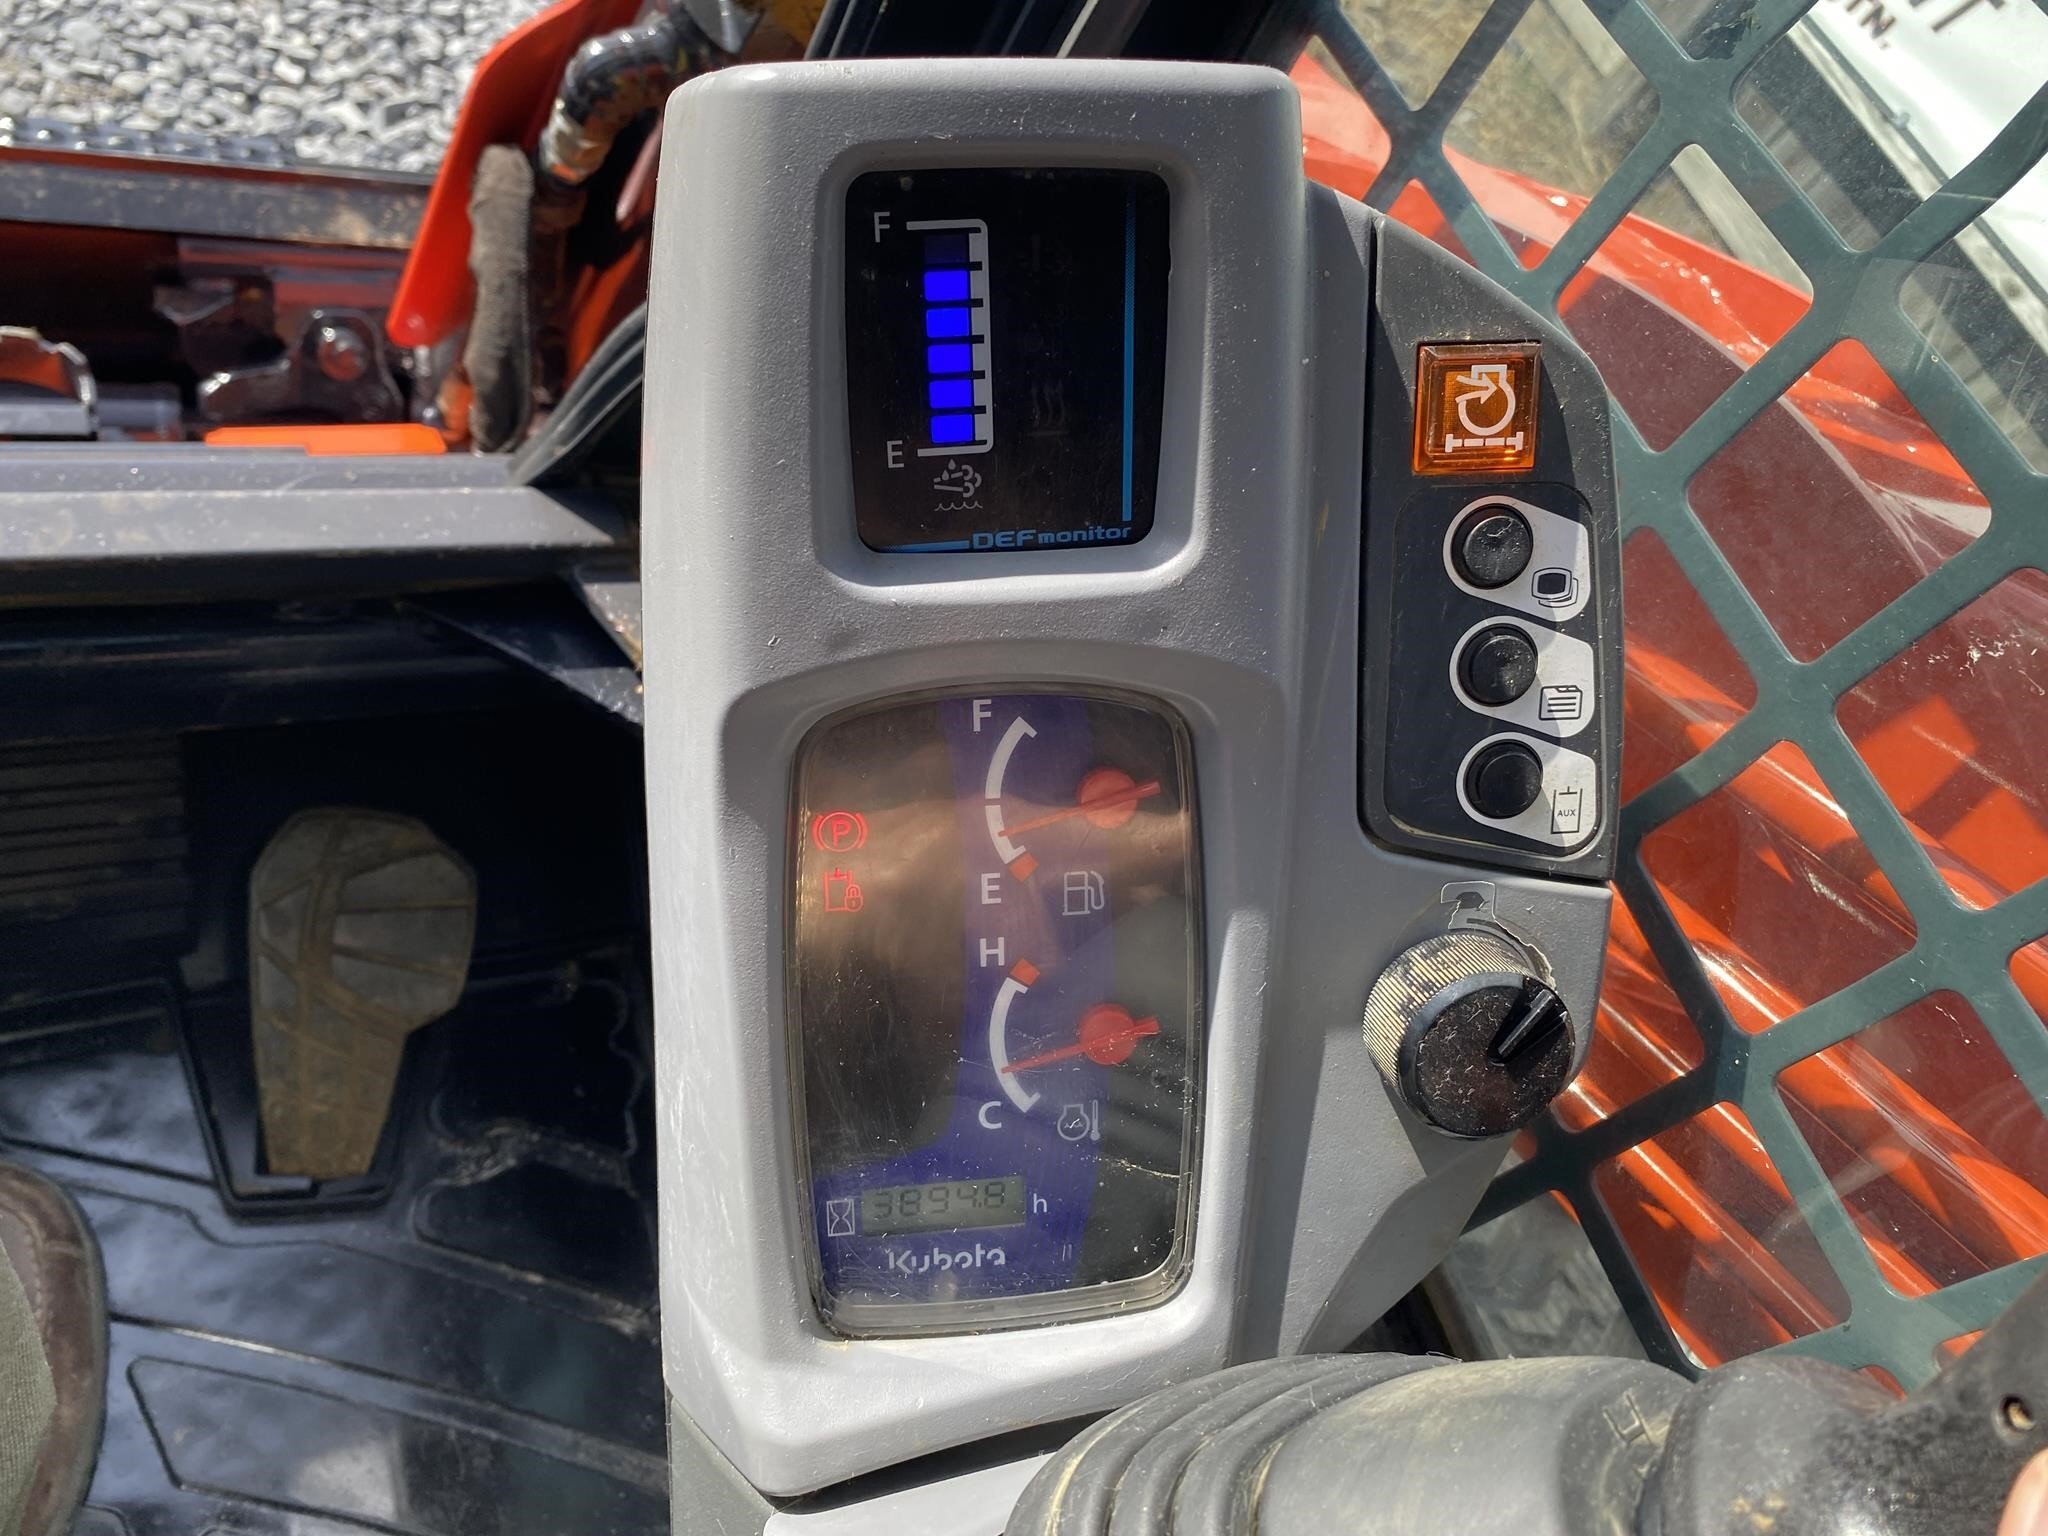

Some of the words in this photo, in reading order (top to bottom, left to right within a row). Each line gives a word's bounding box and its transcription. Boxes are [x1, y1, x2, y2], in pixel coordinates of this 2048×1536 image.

[873, 211, 891, 243] F
[886, 440, 905, 469] E
[971, 699, 993, 733] F
[1557, 808, 1576, 817] AUX
[831, 818, 852, 848] P
[980, 873, 1003, 905] E
[979, 937, 1006, 967] H
[978, 1101, 1003, 1129] C
[1032, 1192, 1048, 1214] h
[888, 1243, 1007, 1274] Kubota
